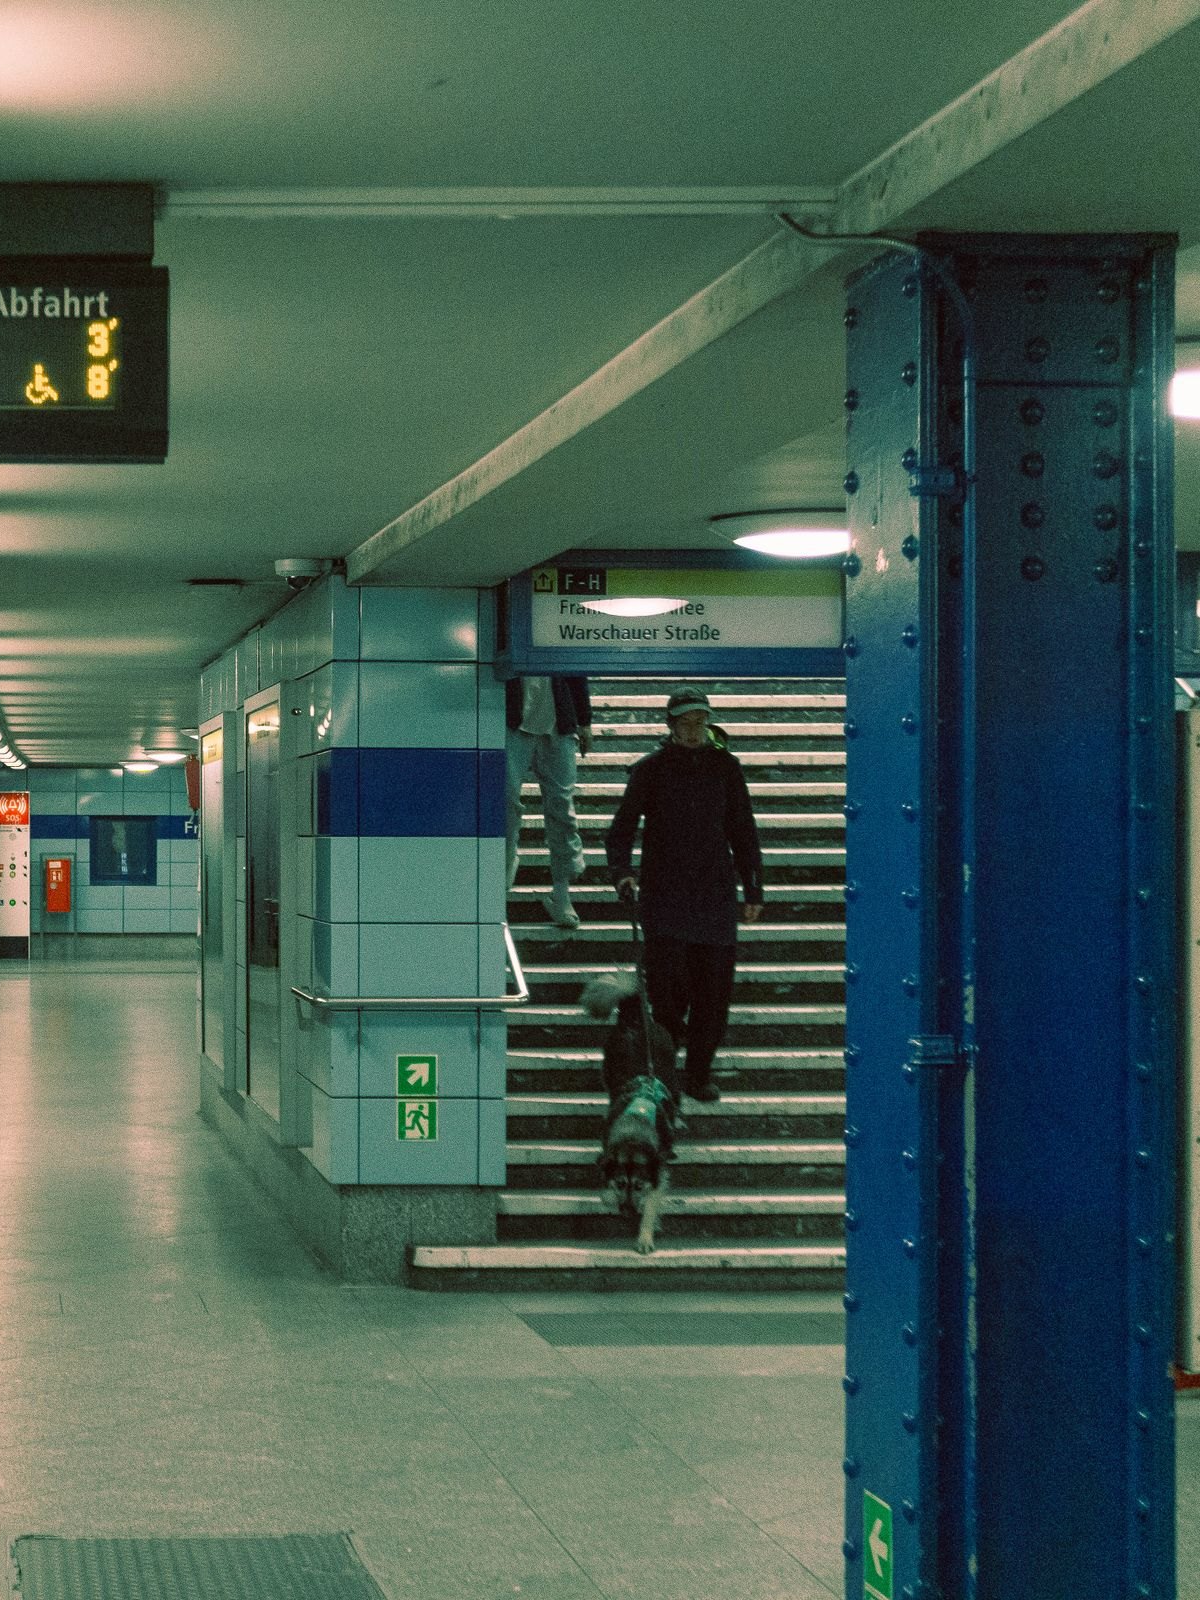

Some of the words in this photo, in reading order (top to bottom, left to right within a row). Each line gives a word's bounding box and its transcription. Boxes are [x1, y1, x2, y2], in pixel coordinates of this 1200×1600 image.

[559, 624, 659, 640] Warschauer
[665, 624, 720, 640] Straße
[5, 814, 20, 822] SOS
